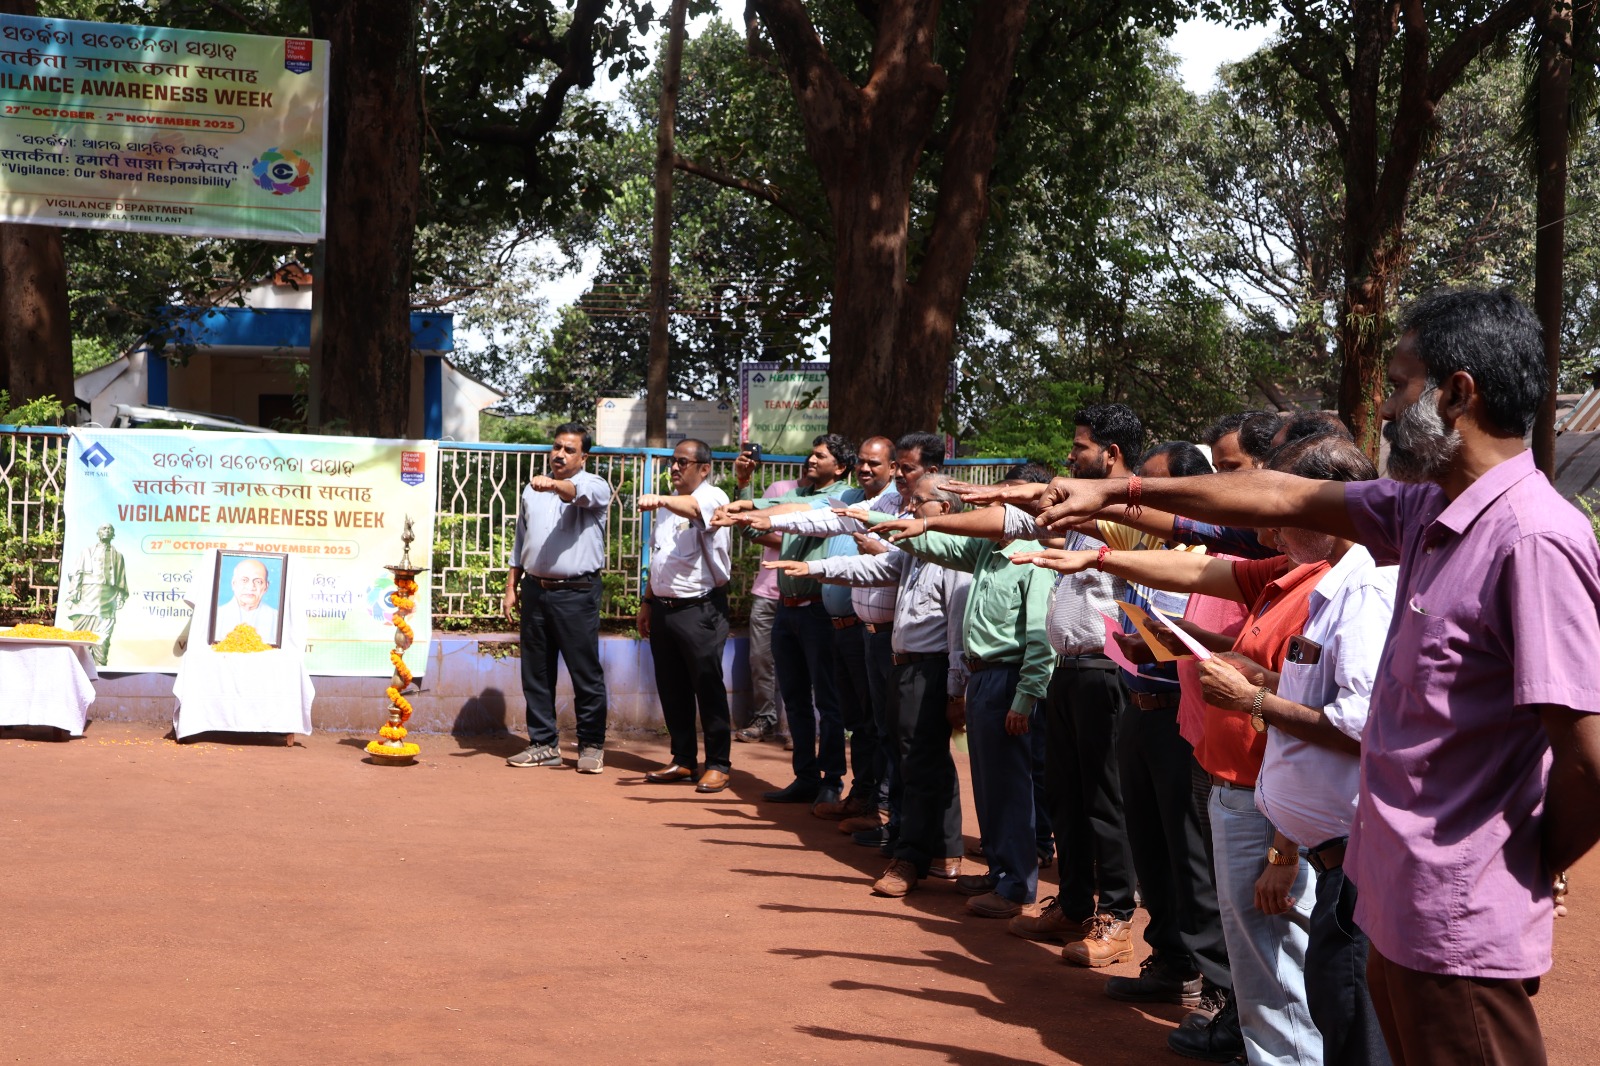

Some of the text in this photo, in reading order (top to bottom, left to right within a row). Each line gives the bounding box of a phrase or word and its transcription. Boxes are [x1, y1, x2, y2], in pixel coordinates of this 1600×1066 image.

[3, 23, 237, 61] ସତର୍କତା ସଚେତନତା ସପ୍ତାହ
[0, 47, 259, 84] तर्कता जागरूकता सप्ताह
[1, 73, 273, 108] ILANCE AWARENESS WEEK
[32, 107, 95, 120] OCTOBER
[126, 115, 201, 127] NOVEMBER
[204, 120, 235, 129] 2025
[75, 153, 120, 168] हमारी
[123, 157, 163, 170] साझा
[168, 157, 238, 174] जिम्मेदारी
[2, 163, 238, 189] “Vigilance: Our Shared Responsibility”
[45, 198, 195, 215] VIGILANCE DEPARTMENT
[81, 211, 128, 220] ROURKELA
[130, 214, 153, 222] STEEL
[768, 373, 826, 382] HEARTFELT
[764, 400, 791, 409] TEAM
[801, 424, 828, 432] CONTR
[152, 446, 355, 477] ସତର୍କତା ସଚେତନତା ସପ୍ତାହ
[132, 474, 373, 503] सतर्कता जागरूकता सप्ताह
[117, 504, 385, 528] VIGILANCE AWARENESS WEEK
[172, 540, 228, 550] OCTOBER
[255, 543, 321, 555] NOVEMBER
[324, 546, 351, 555] 2025
